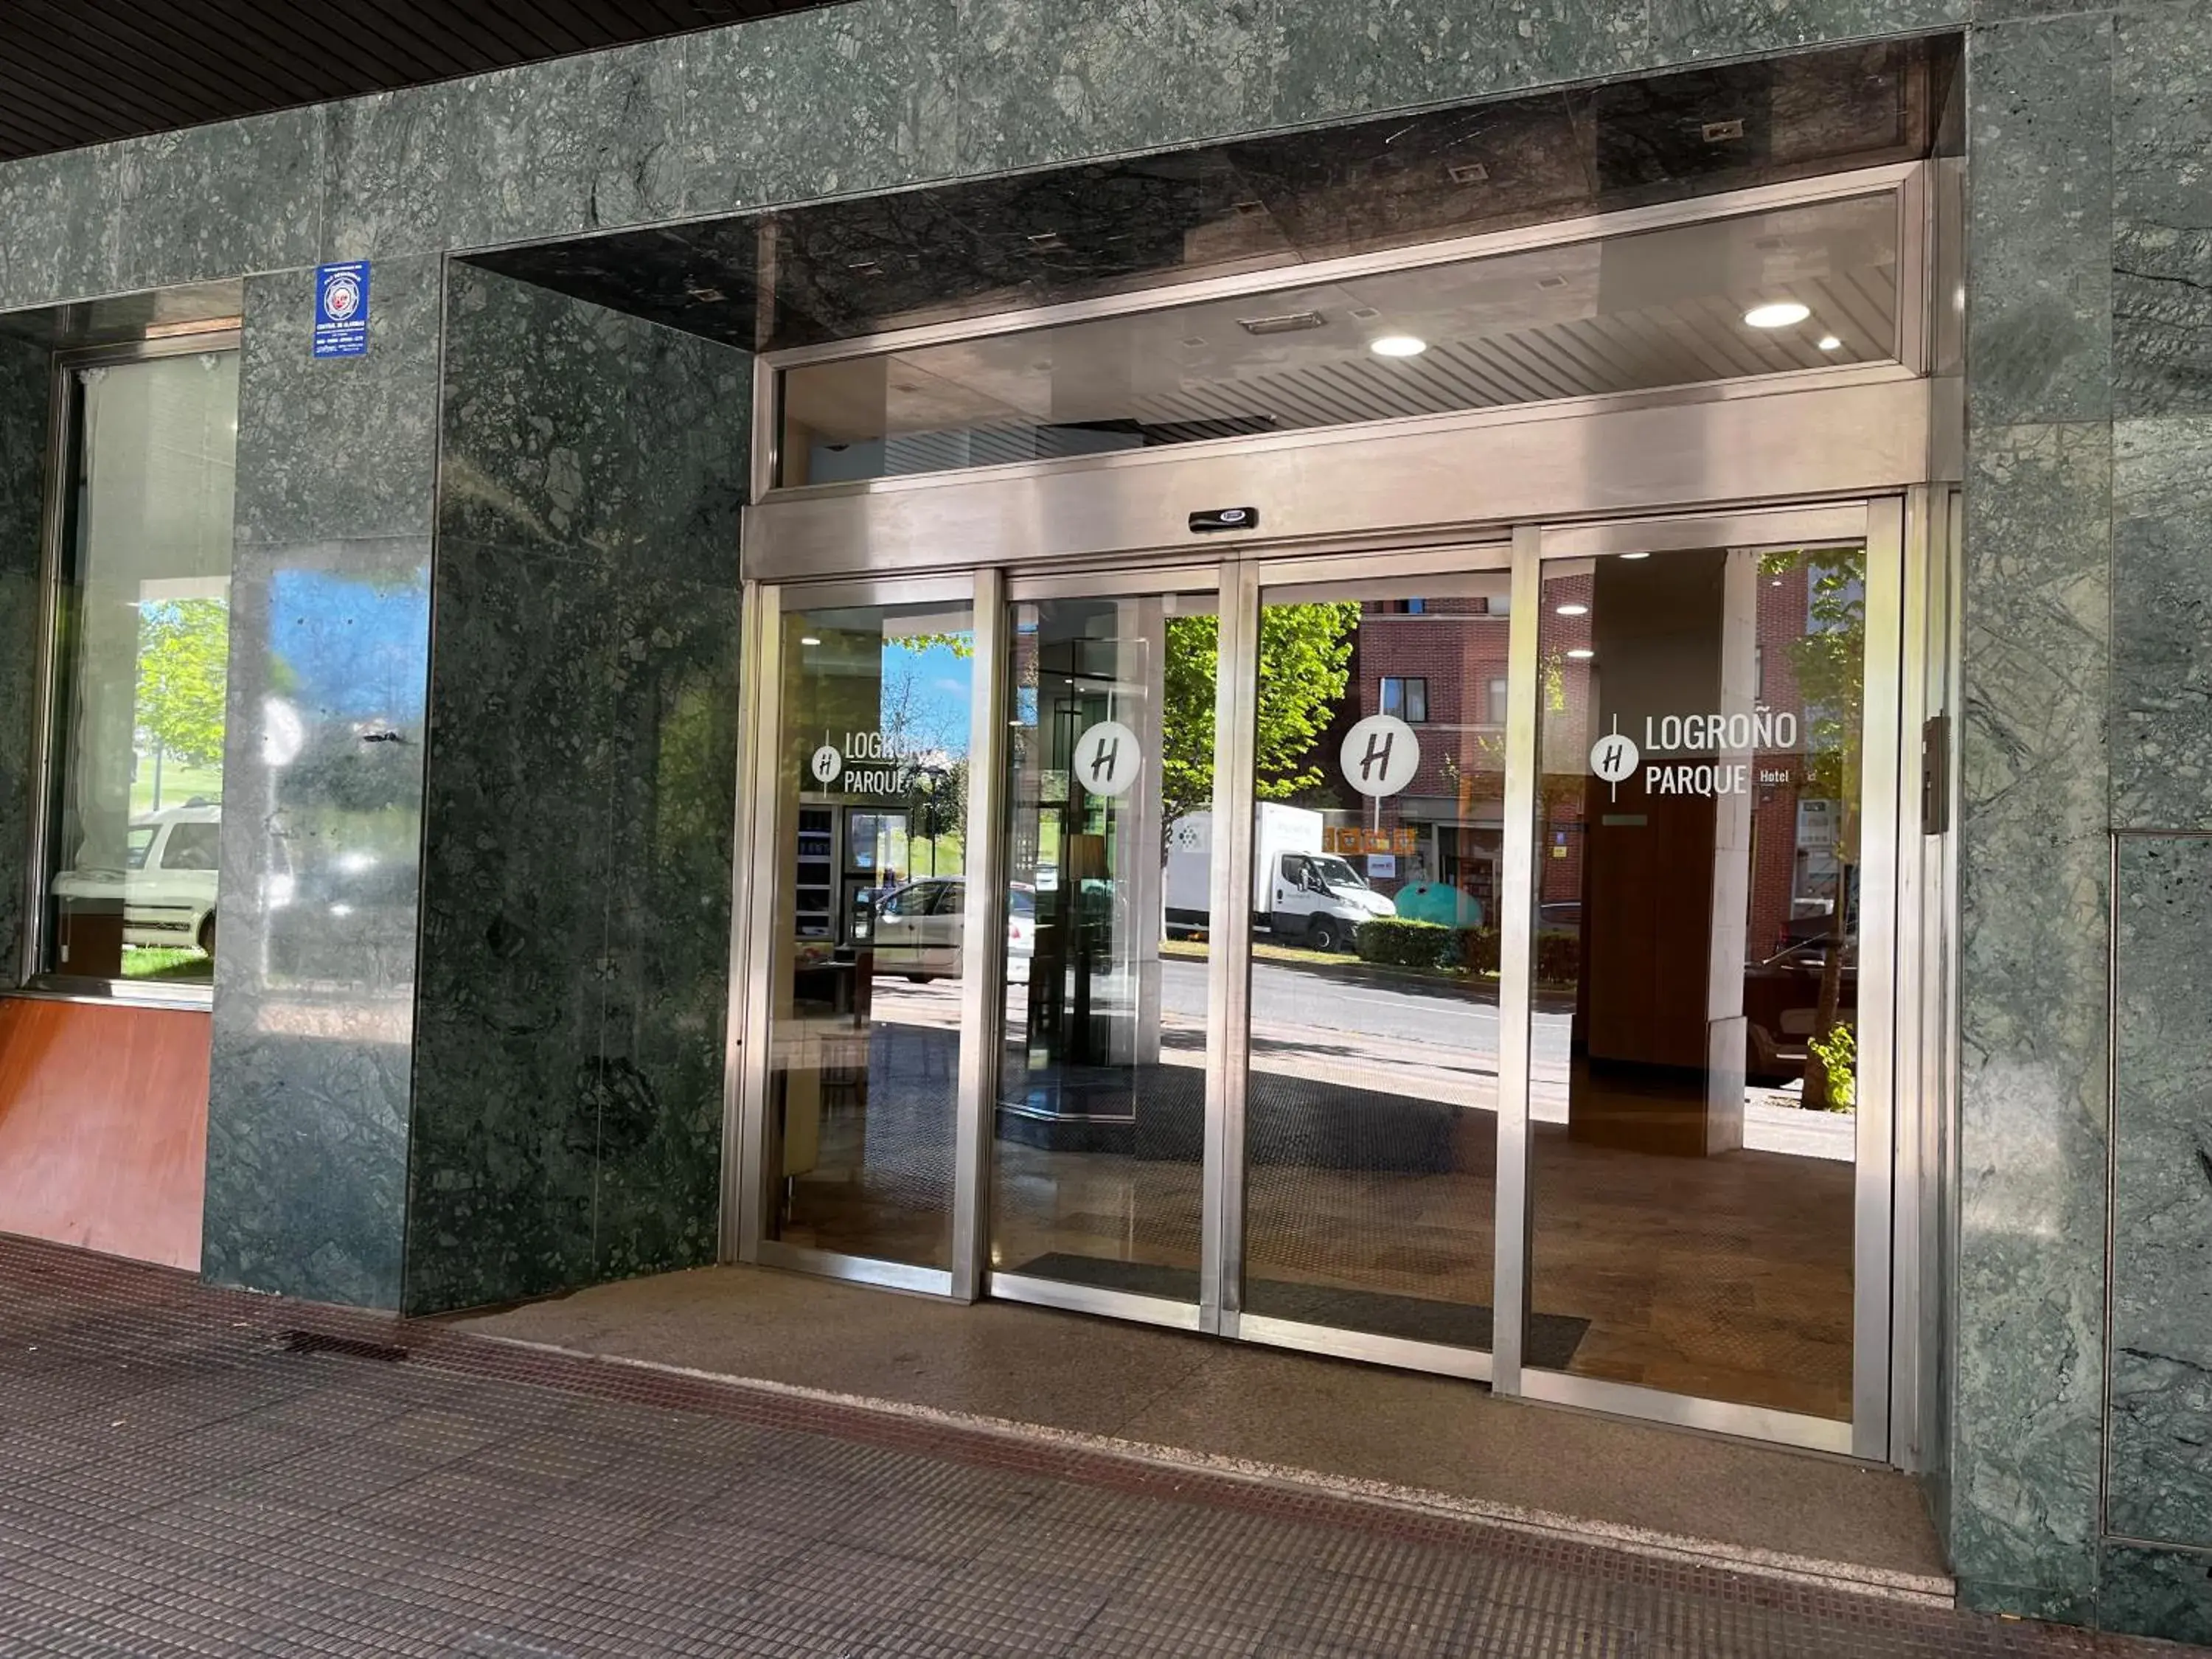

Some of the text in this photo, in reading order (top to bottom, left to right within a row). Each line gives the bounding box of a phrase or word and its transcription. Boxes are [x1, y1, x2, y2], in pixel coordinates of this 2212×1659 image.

[1645, 706, 1798, 750] LOGROÑO
[1091, 737, 1119, 782] H
[1360, 731, 1394, 782] H
[1602, 744, 1622, 773] H
[844, 770, 905, 796] PARQUE
[1645, 765, 1789, 798] PARQUE Hotel
